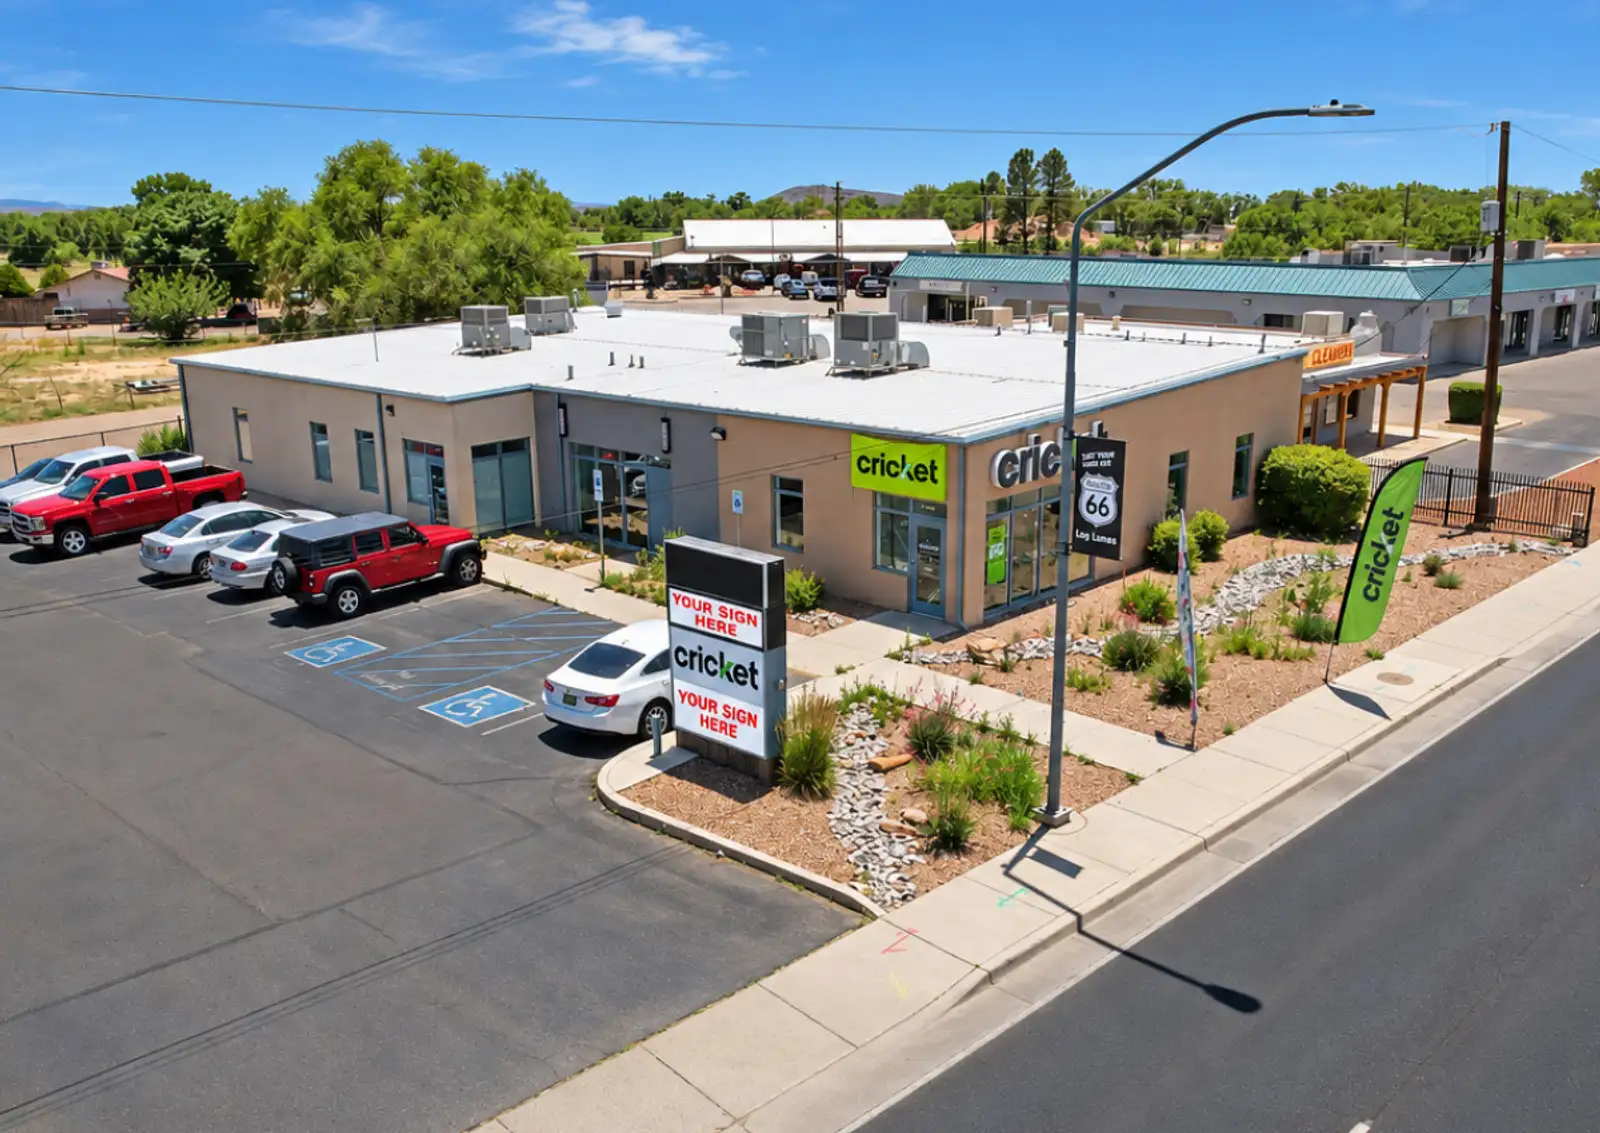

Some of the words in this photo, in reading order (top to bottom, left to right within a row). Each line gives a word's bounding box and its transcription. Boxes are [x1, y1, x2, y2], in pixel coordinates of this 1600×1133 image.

[856, 453, 938, 484] cricket
[1086, 494, 1109, 517] 66
[1363, 507, 1404, 602] cricket
[672, 593, 712, 613] YOUR
[719, 606, 758, 628] SIGN
[695, 614, 737, 636] HERE
[674, 645, 759, 690] cricket
[678, 689, 718, 713] YOUR
[722, 704, 758, 728] SIGN
[700, 714, 737, 738] HERE
